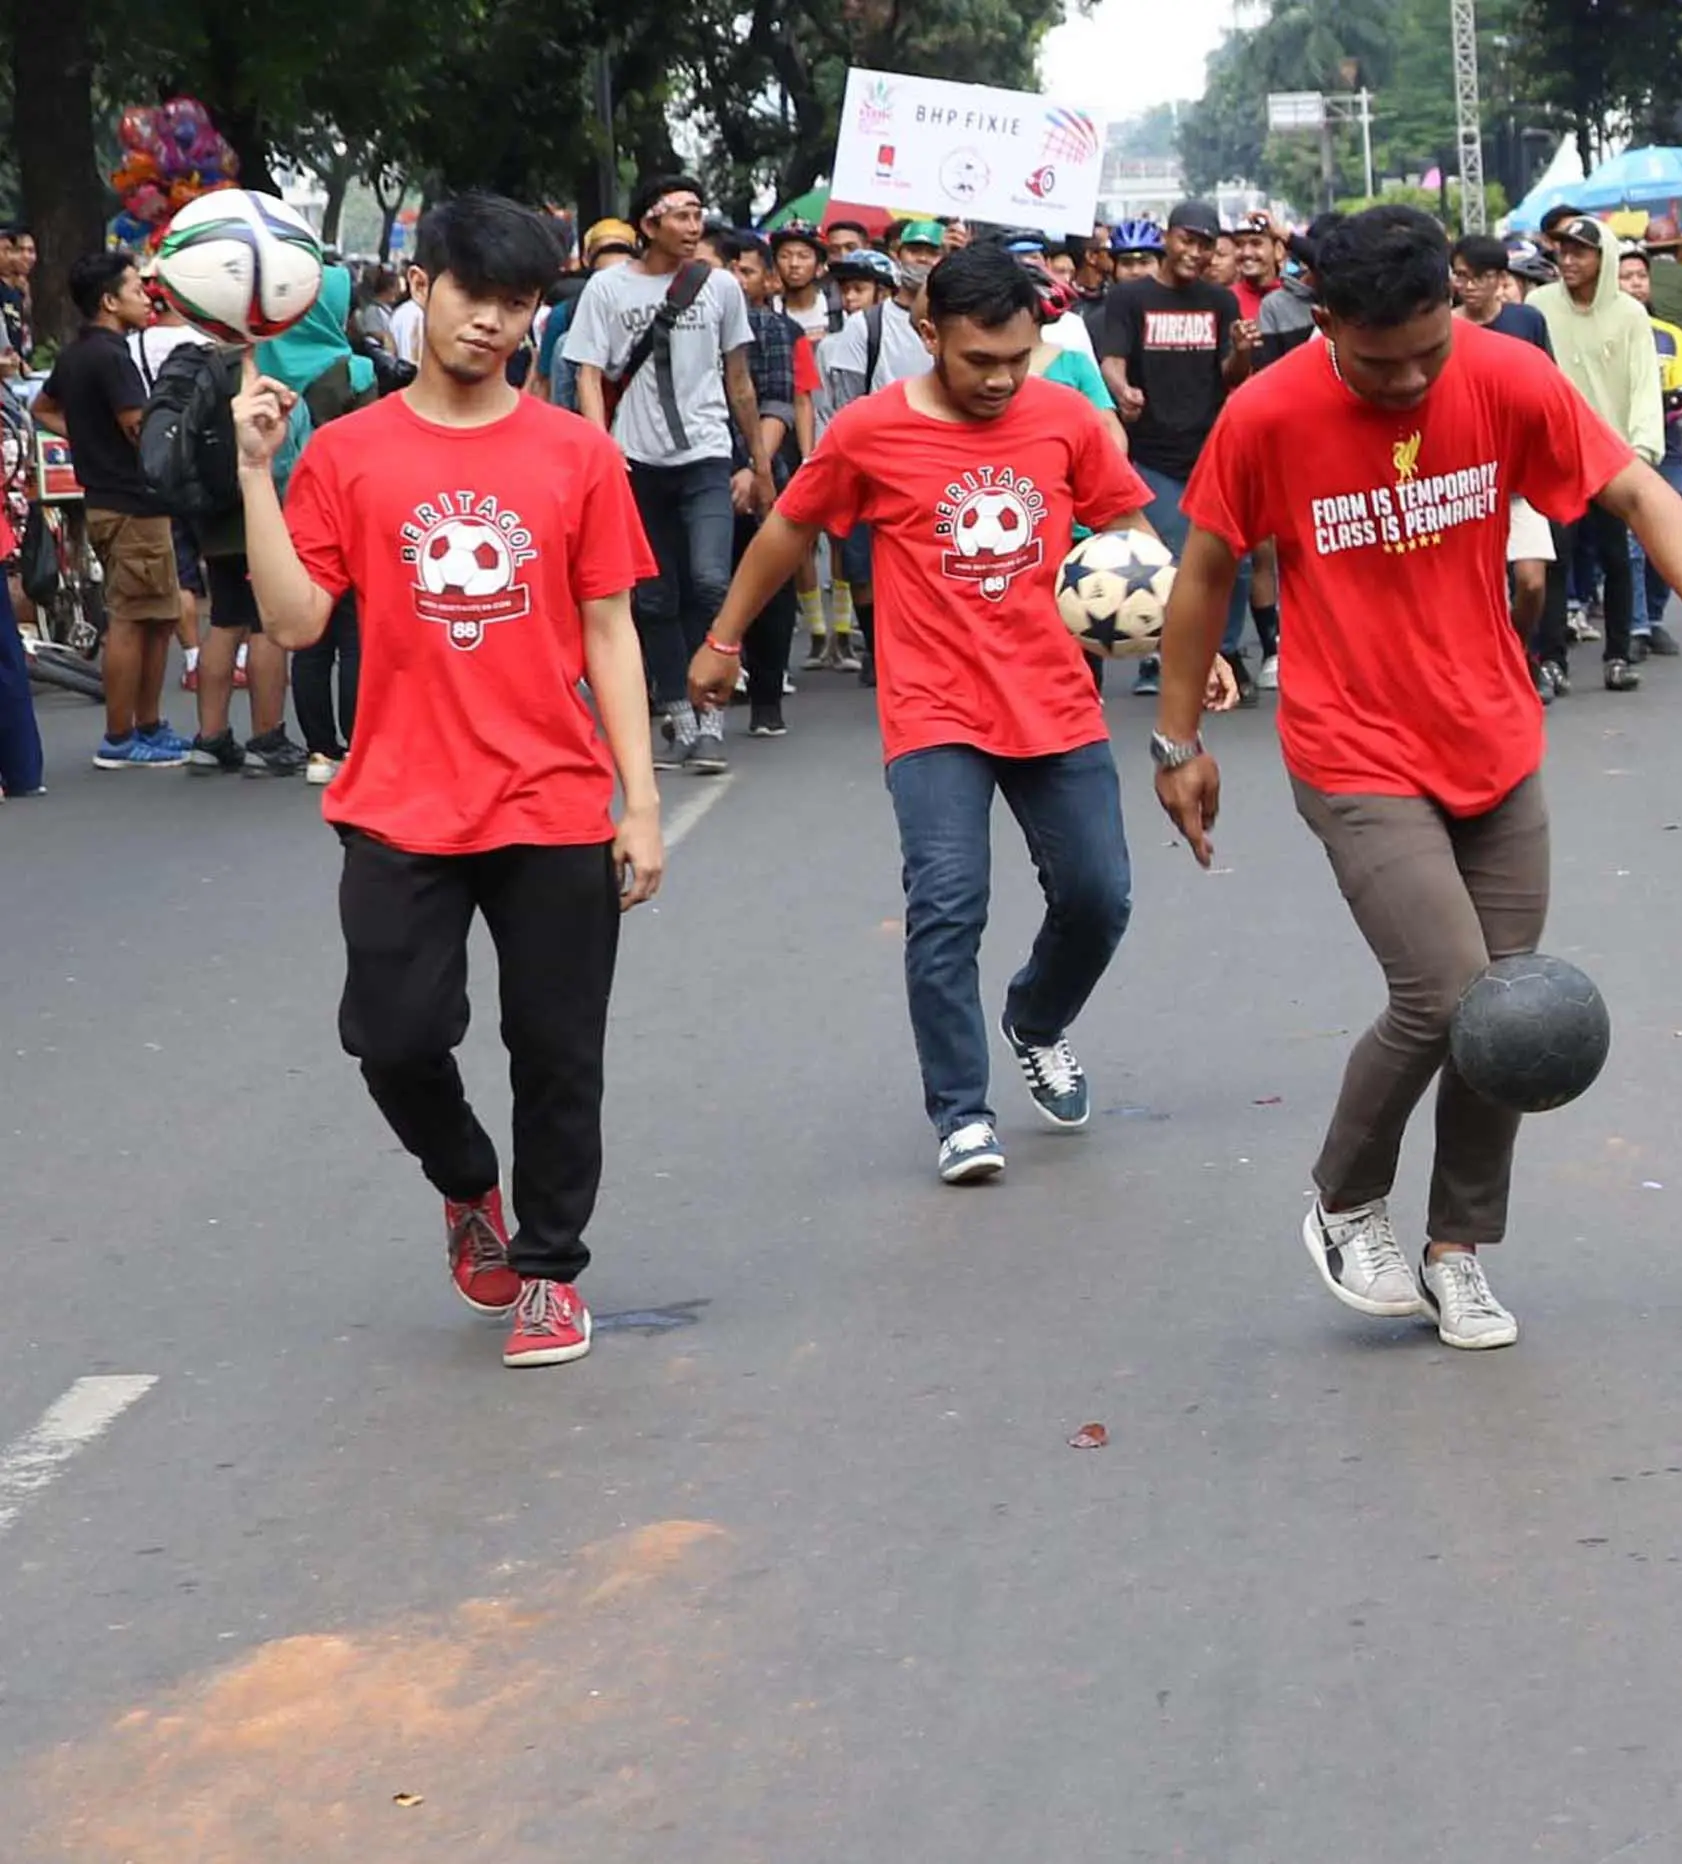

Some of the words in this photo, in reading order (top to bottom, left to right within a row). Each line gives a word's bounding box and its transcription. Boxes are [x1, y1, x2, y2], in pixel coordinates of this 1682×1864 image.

[916, 104, 957, 125] BHP
[965, 112, 1021, 136] FIXIE
[934, 466, 1048, 536] BERITAGOL
[1311, 492, 1367, 528] FORM
[1370, 487, 1392, 517] IS
[1316, 519, 1377, 555] CLASS
[1381, 516, 1400, 543] IS
[1403, 487, 1498, 539] PERMANET
[401, 490, 537, 567] BERITAGOL
[452, 621, 478, 638] 88
